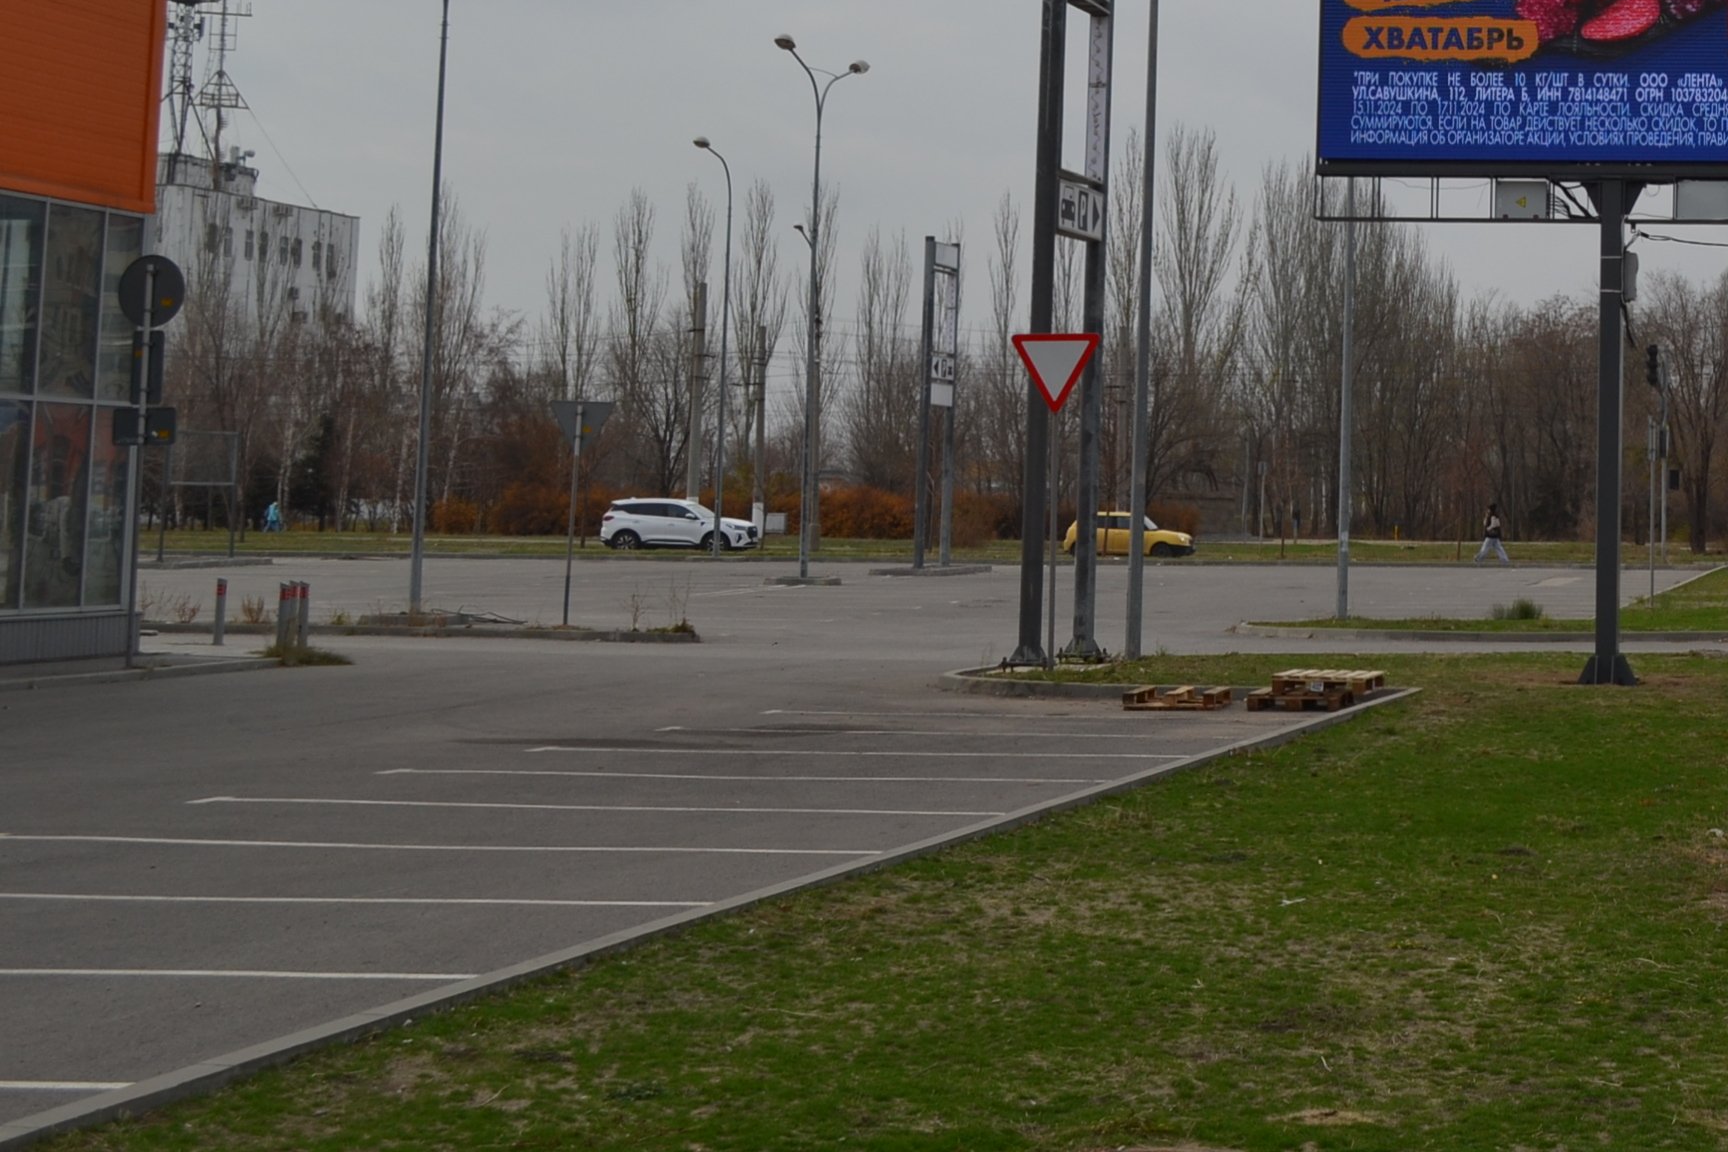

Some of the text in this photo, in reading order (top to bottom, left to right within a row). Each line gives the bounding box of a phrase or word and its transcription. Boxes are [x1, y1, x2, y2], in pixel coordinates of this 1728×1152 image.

[1361, 26, 1525, 51] ХВАТАБРЬ
[1388, 72, 1438, 86] ПОКУПКЕ
[1447, 72, 1461, 86] НЕ
[1470, 73, 1504, 87] БОЛЕЕ
[1514, 73, 1526, 87] 10
[1535, 73, 1569, 89] КГ/ШТ
[1577, 73, 1585, 87] В
[1639, 73, 1669, 87] ООО
[1677, 74, 1723, 88] «ЛЕНТА»
[1474, 87, 1515, 101] ЛИТЕРА
[1537, 87, 1562, 101] ИНН
[1568, 87, 1628, 101] 7814148471
[1635, 87, 1664, 101] ОГРН
[1410, 101, 1428, 115] ПО
[1493, 102, 1511, 116] ПО
[1519, 102, 1549, 116] КАРТЕ
[1640, 102, 1685, 116] СКИДКА
[1438, 116, 1467, 130] ЕСЛИ
[1470, 117, 1486, 131] НА
[1489, 117, 1522, 131] ТОВАР
[1585, 117, 1648, 131] НЕСКОЛЬКО
[1703, 118, 1718, 132] ТО
[1350, 131, 1428, 145] ИНФОРМАЦИЯ
[1430, 131, 1446, 145] ОБ
[1447, 132, 1524, 146] ОРГАНИЗАТОРЕ
[1568, 132, 1625, 146] УСЛОВИЯХ
